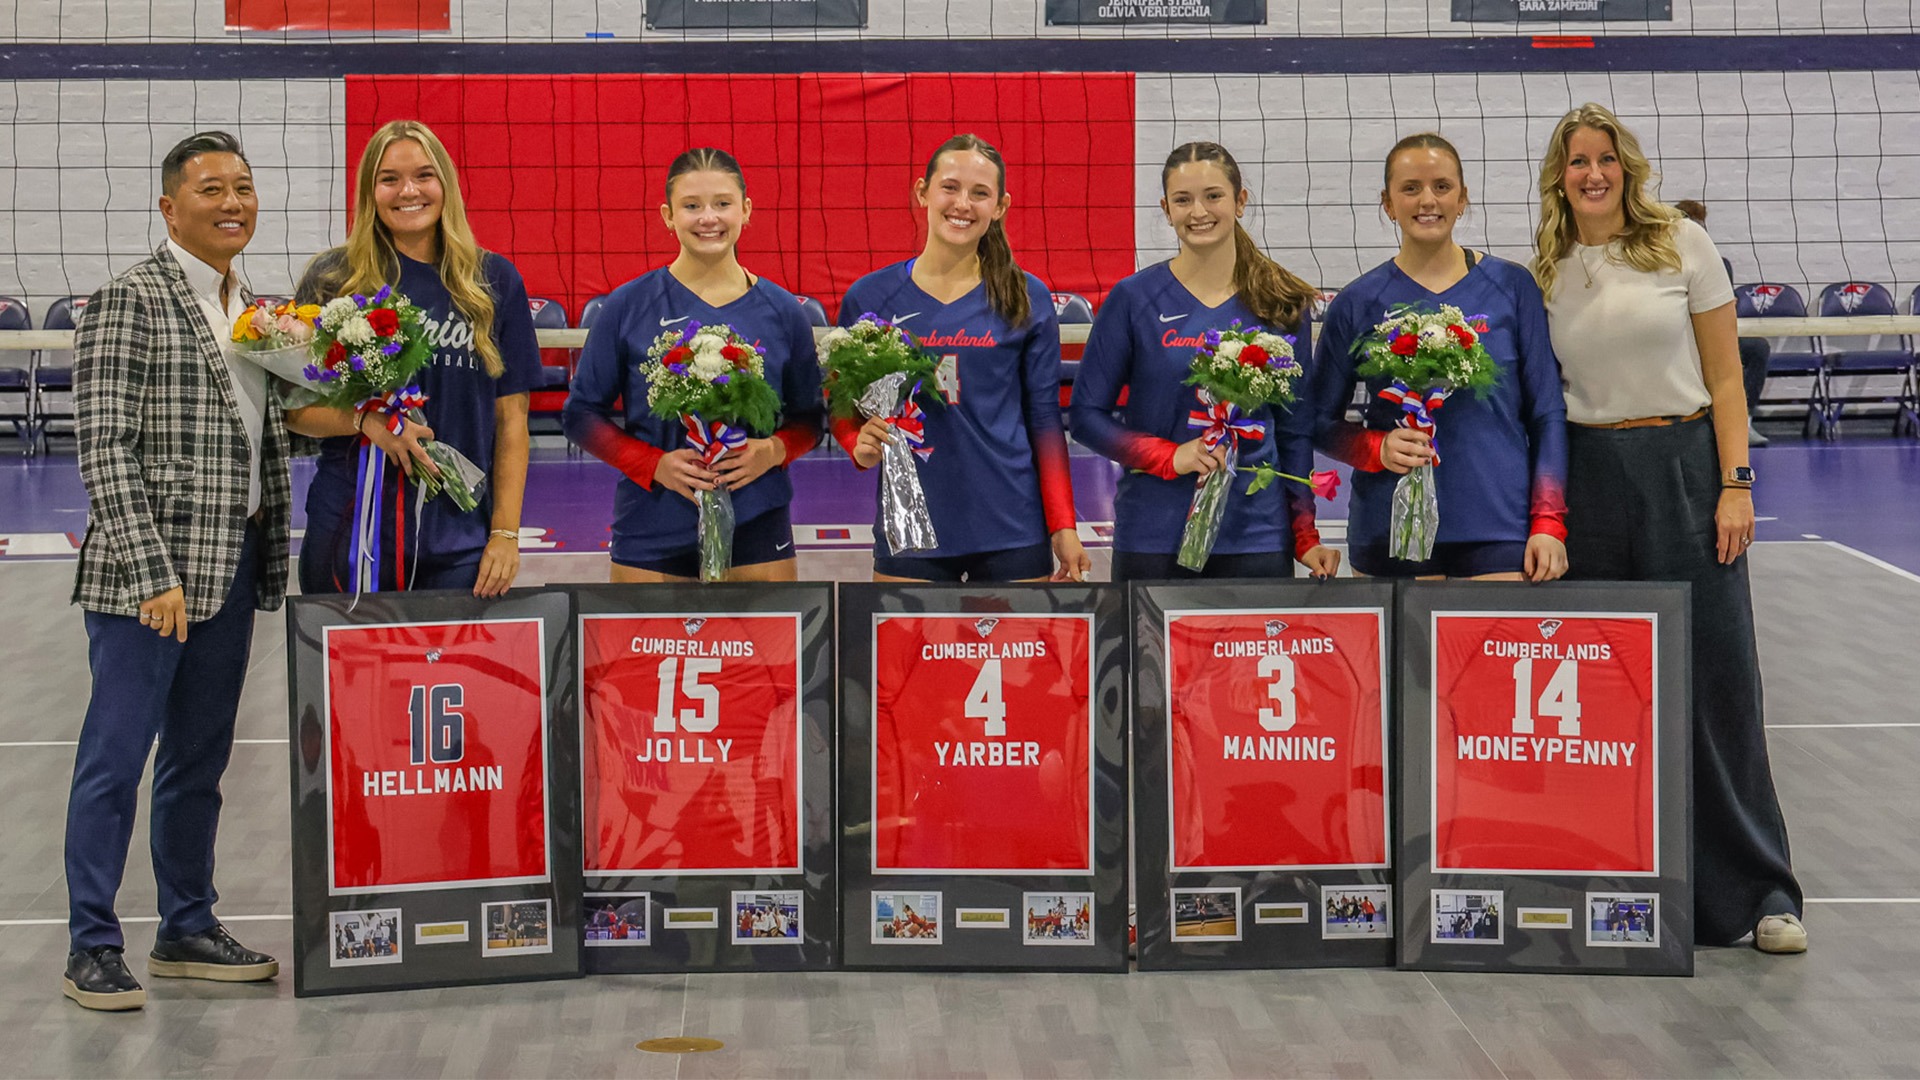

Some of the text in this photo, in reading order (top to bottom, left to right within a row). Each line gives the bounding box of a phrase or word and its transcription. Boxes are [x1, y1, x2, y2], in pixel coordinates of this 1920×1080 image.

[1098, 6, 1136, 18] OLIVIA
[1519, 1, 1546, 11] SARA
[631, 636, 754, 659] CUMBERLANDS
[922, 641, 1046, 661] CUMBERLANDS
[1213, 637, 1334, 658] CUMBERLANDS
[1484, 640, 1611, 660] CUMBERLANDS
[654, 657, 721, 733] 15
[964, 658, 1006, 737] 4
[1256, 653, 1296, 732] 3
[1512, 657, 1581, 737] 14
[408, 683, 464, 766] 16
[636, 738, 733, 763] JOLLY
[934, 741, 1040, 766] YARBER
[1223, 735, 1336, 761] MANNING
[1458, 735, 1636, 767] MONEYPENNY
[363, 765, 503, 797] HELLMANN
